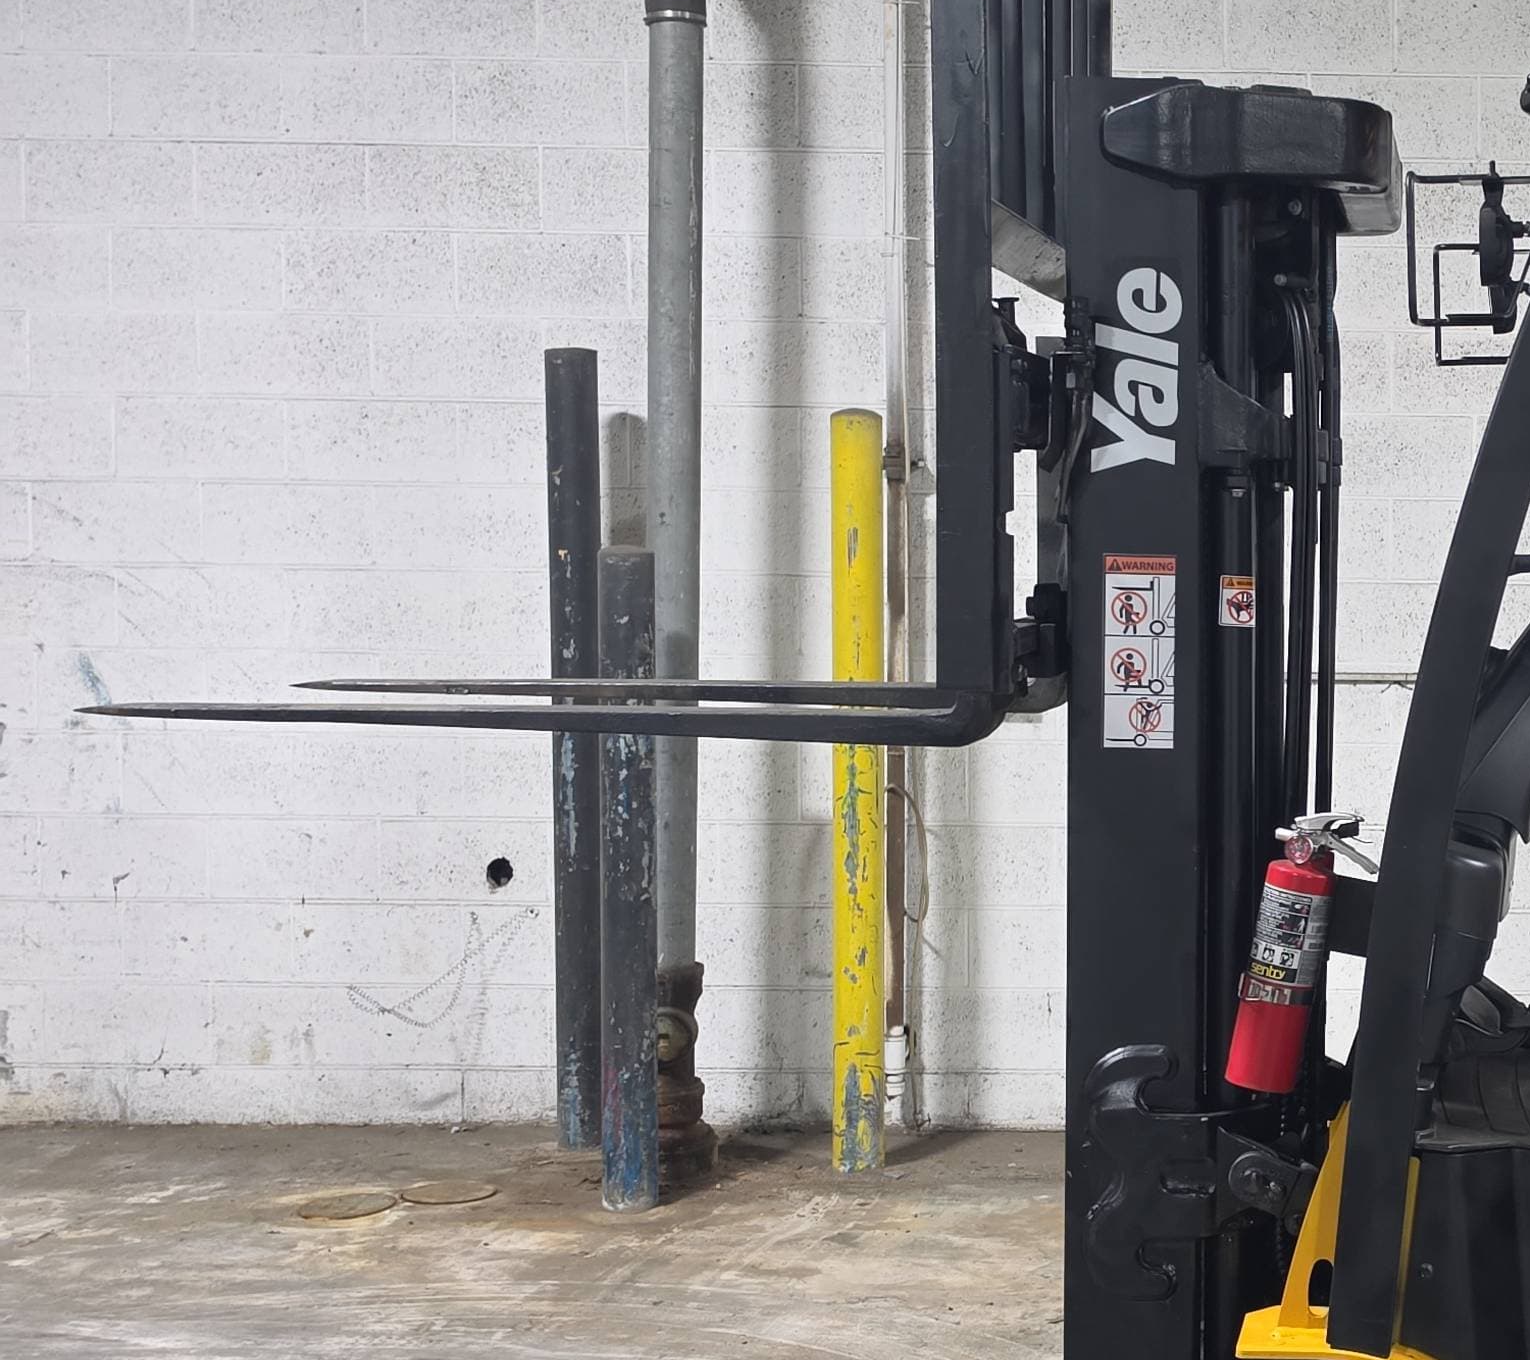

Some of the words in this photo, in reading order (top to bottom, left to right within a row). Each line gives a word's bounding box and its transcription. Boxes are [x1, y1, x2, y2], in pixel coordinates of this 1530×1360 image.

[1091, 267, 1183, 473] Yale
[1121, 560, 1174, 572] WARNING
[1250, 962, 1286, 980] sentry
